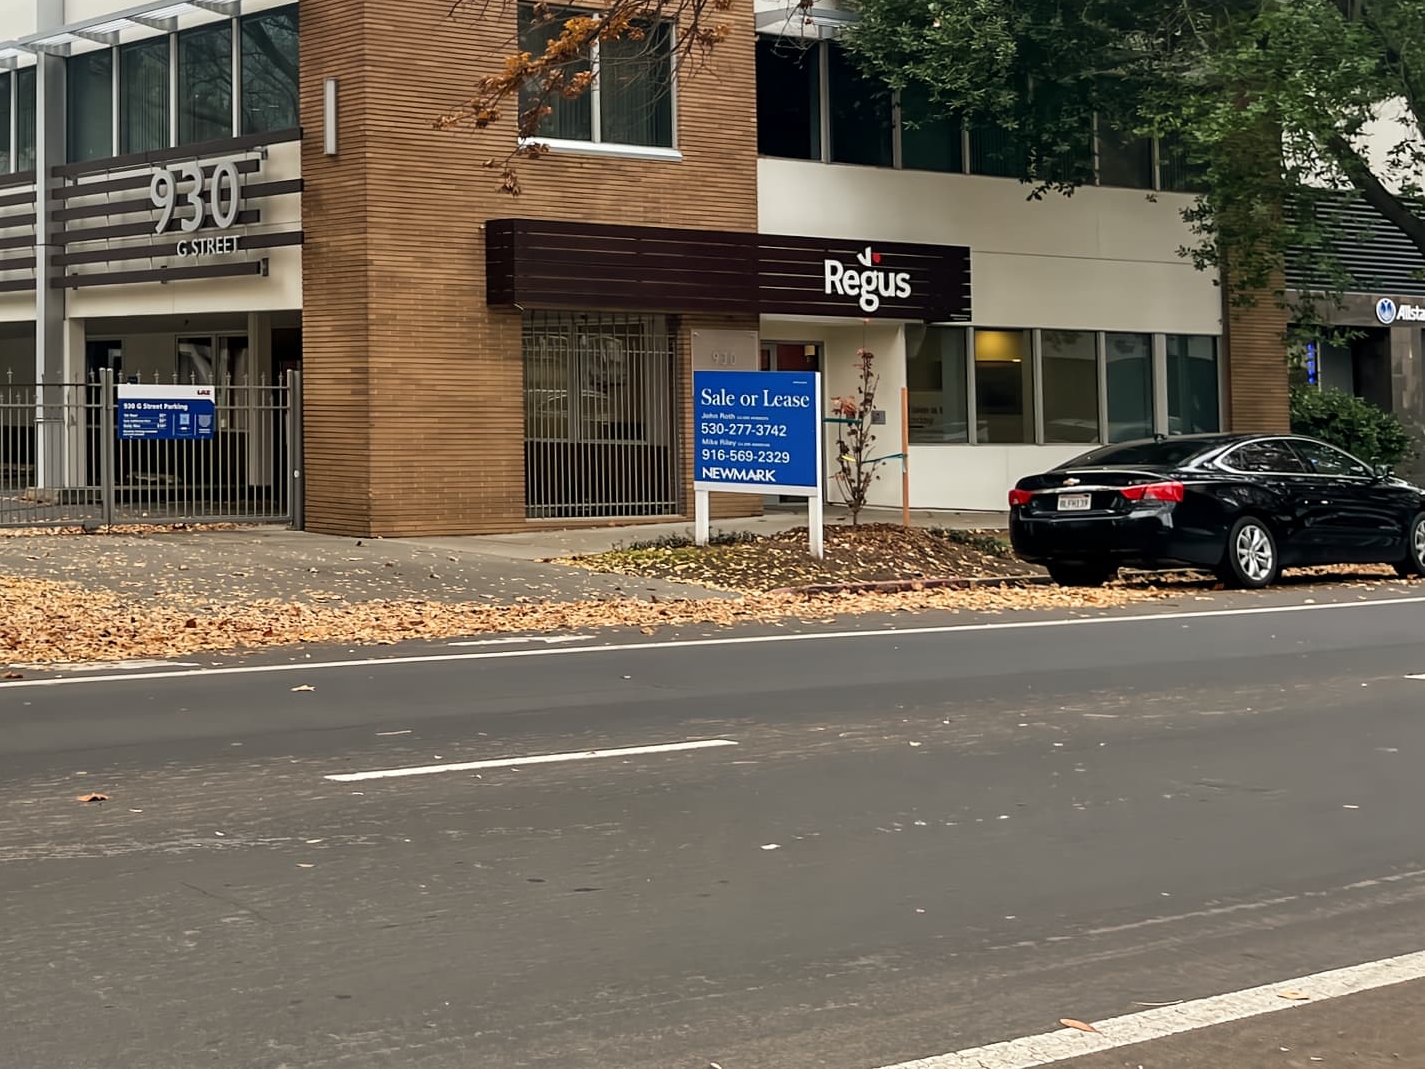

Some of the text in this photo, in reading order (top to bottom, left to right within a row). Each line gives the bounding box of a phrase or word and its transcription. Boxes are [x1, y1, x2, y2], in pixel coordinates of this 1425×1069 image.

[150, 162, 239, 234] 930
[177, 235, 240, 258] G STREET
[824, 259, 912, 313] Regus
[164, 403, 188, 411] Parking
[701, 388, 810, 408] Sale or Lease
[701, 422, 787, 437] 530-277-3742
[702, 448, 790, 464] 916-569-2329
[702, 466, 776, 482] NEWMARK
